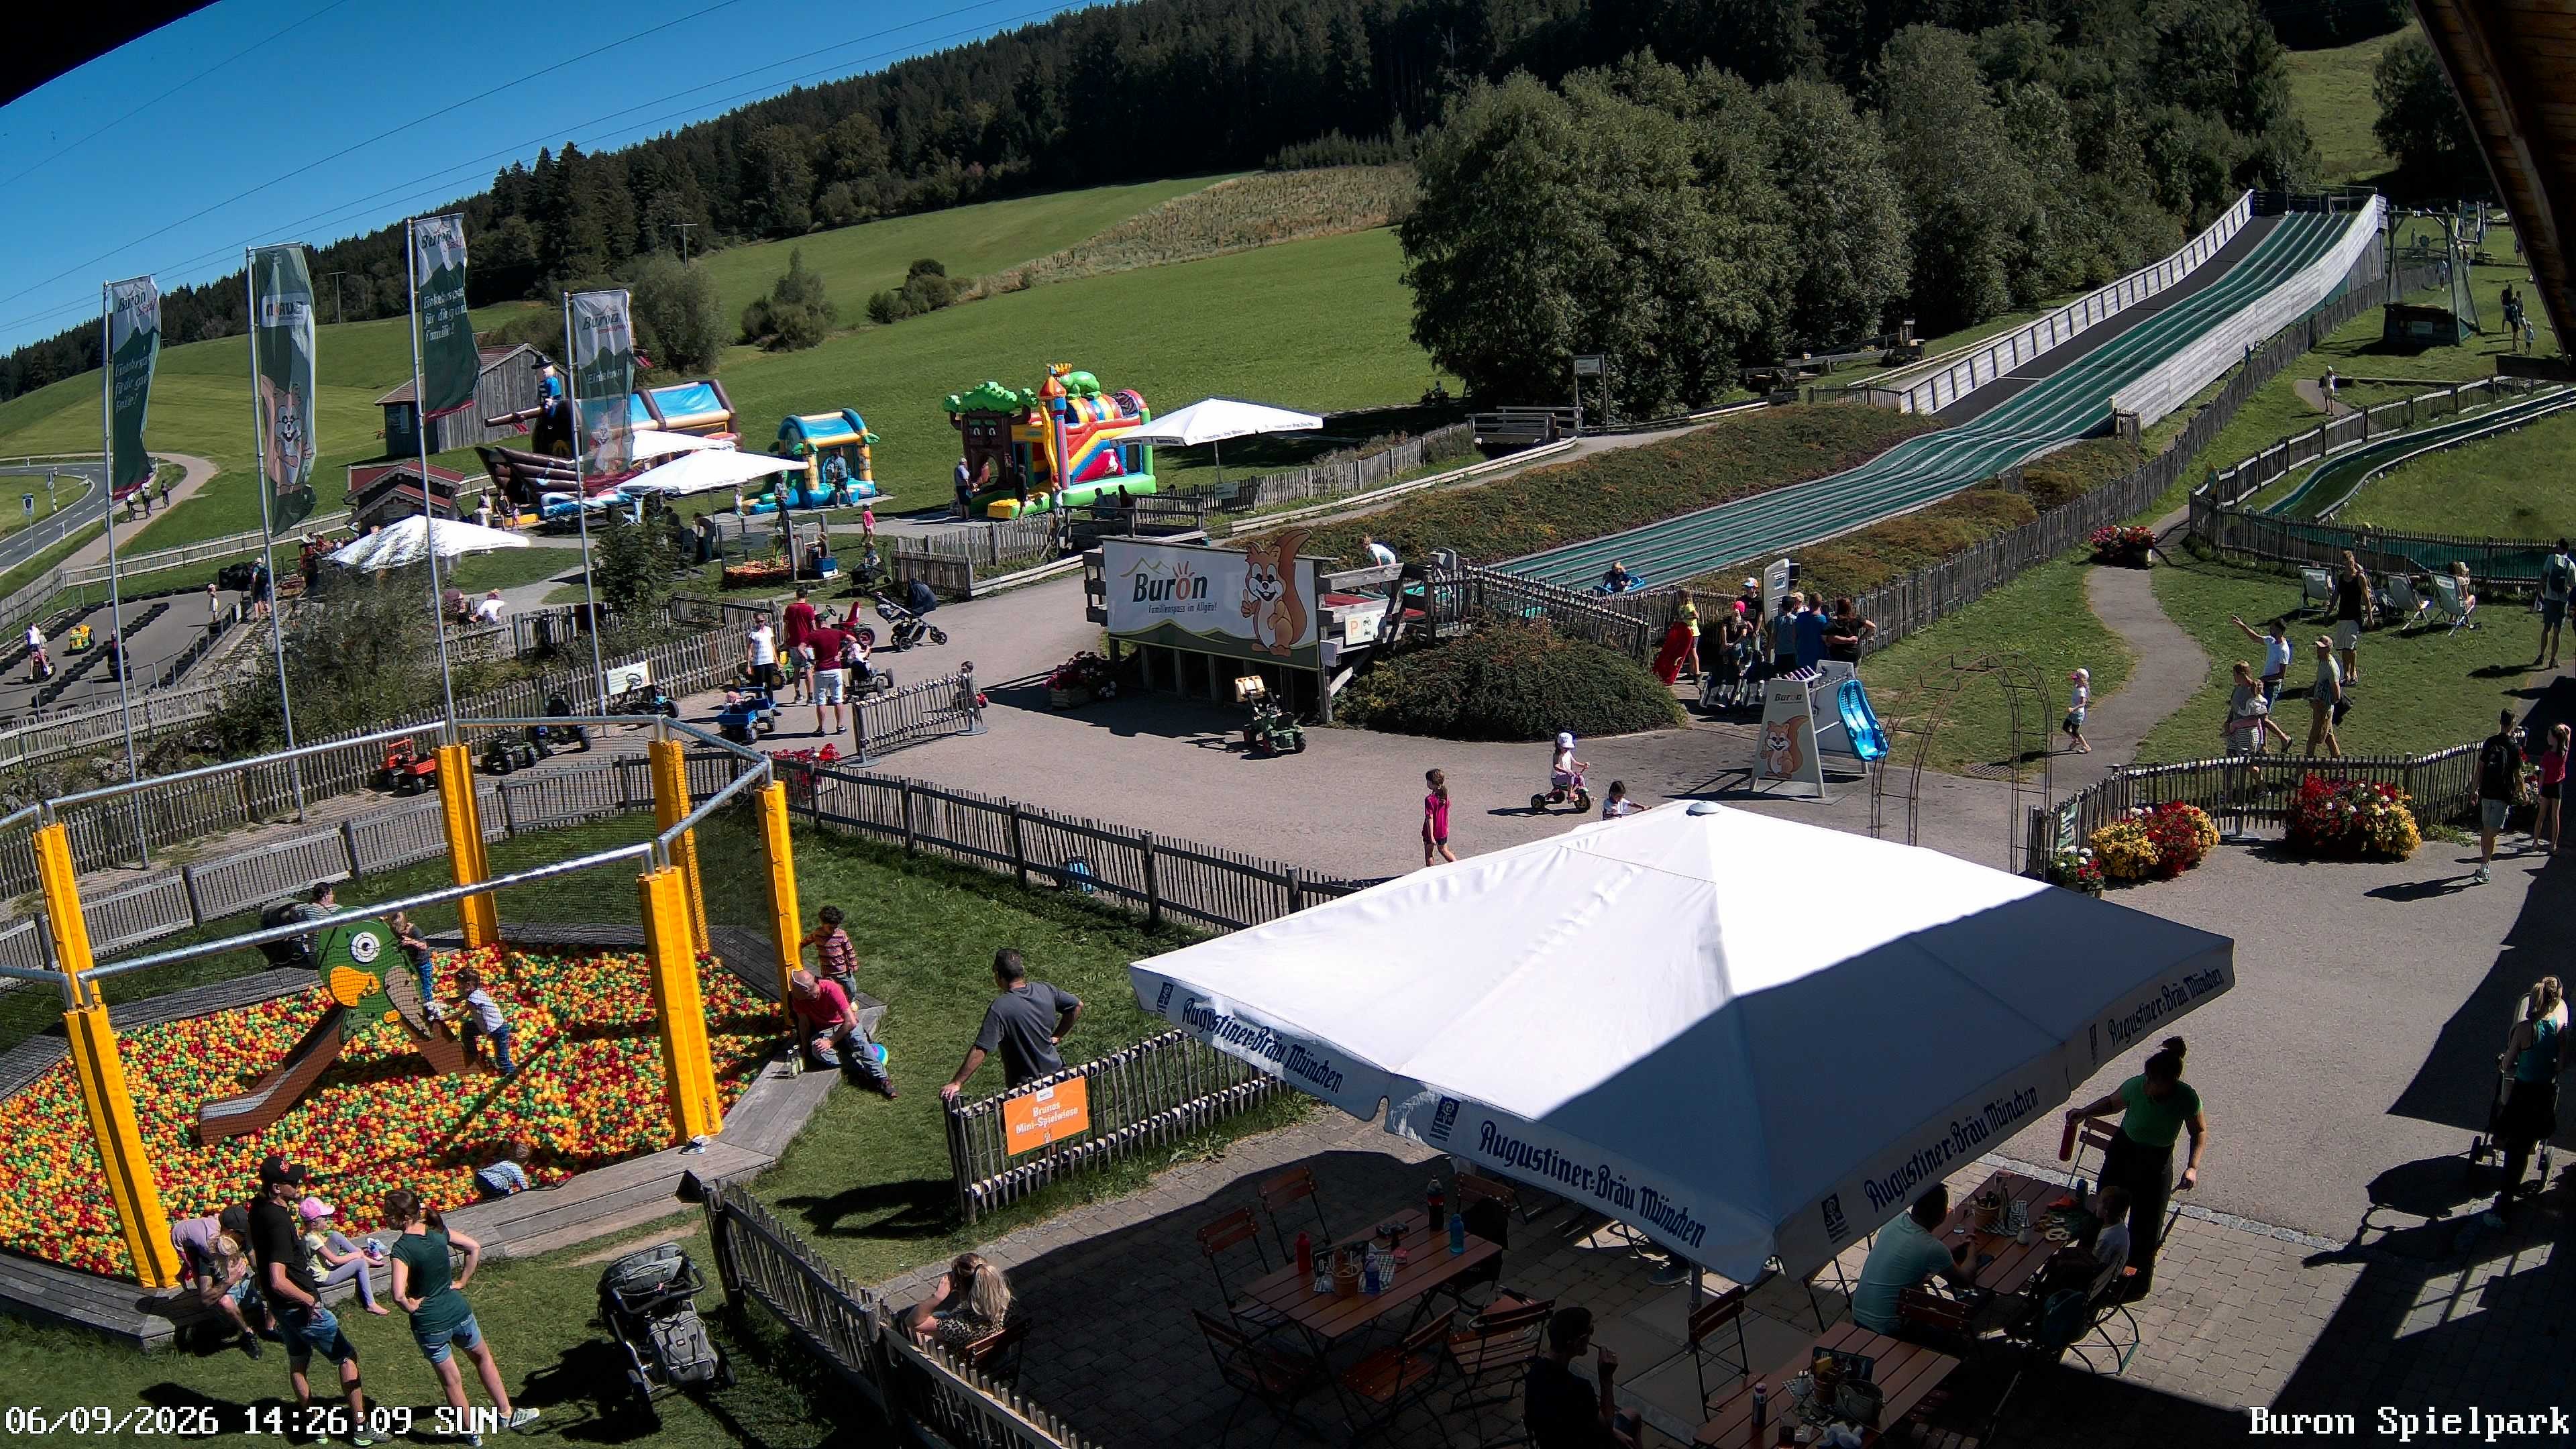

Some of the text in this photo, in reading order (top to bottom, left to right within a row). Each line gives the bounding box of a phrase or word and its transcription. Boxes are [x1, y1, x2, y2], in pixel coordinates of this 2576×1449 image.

[1132, 573, 1208, 602] Buron
[1350, 621, 1358, 636] P
[2183, 968, 2224, 999] München
[1284, 1043, 1343, 1094] München
[1016, 1107, 1079, 1134] Mini-Spielwiese
[1983, 1086, 2040, 1134] München
[1640, 1185, 1707, 1250] München
